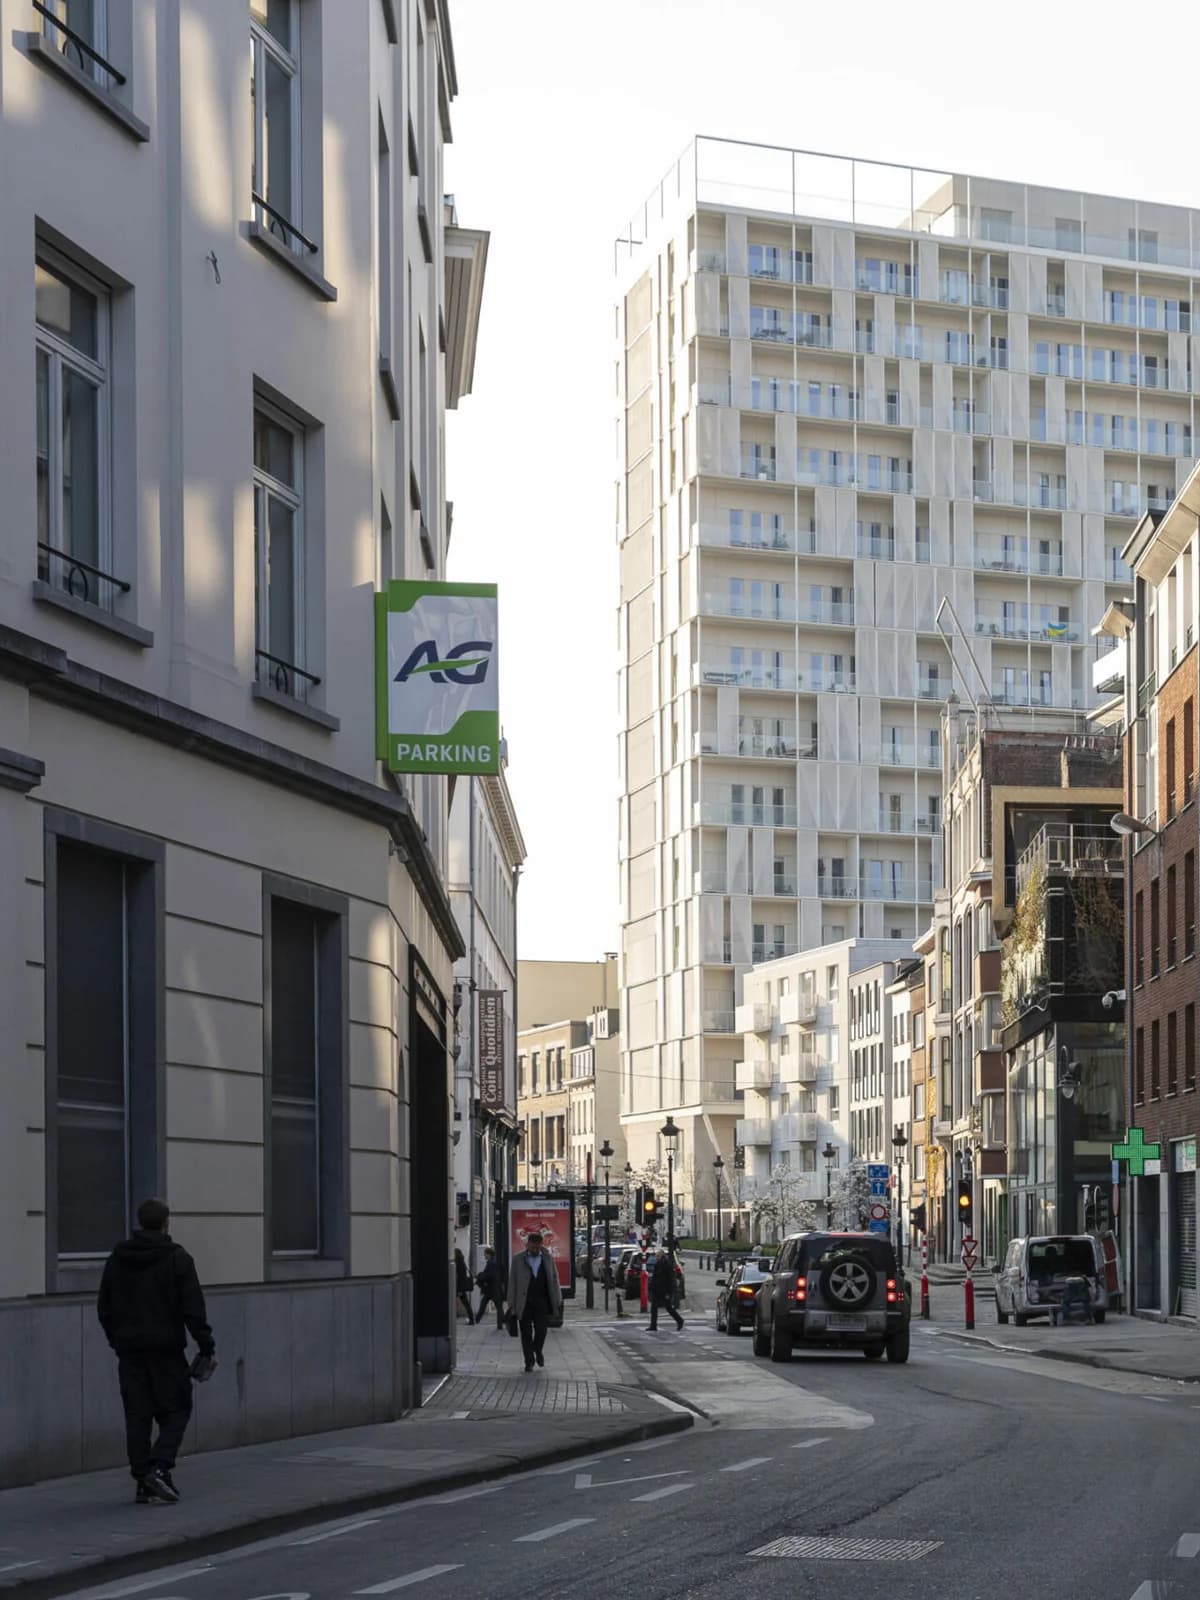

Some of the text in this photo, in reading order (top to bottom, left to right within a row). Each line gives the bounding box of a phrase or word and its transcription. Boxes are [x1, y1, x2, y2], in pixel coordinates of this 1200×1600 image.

[393, 640, 493, 685] AG
[397, 743, 491, 763] PARKING
[485, 997, 498, 1103] Coin Quotidien
